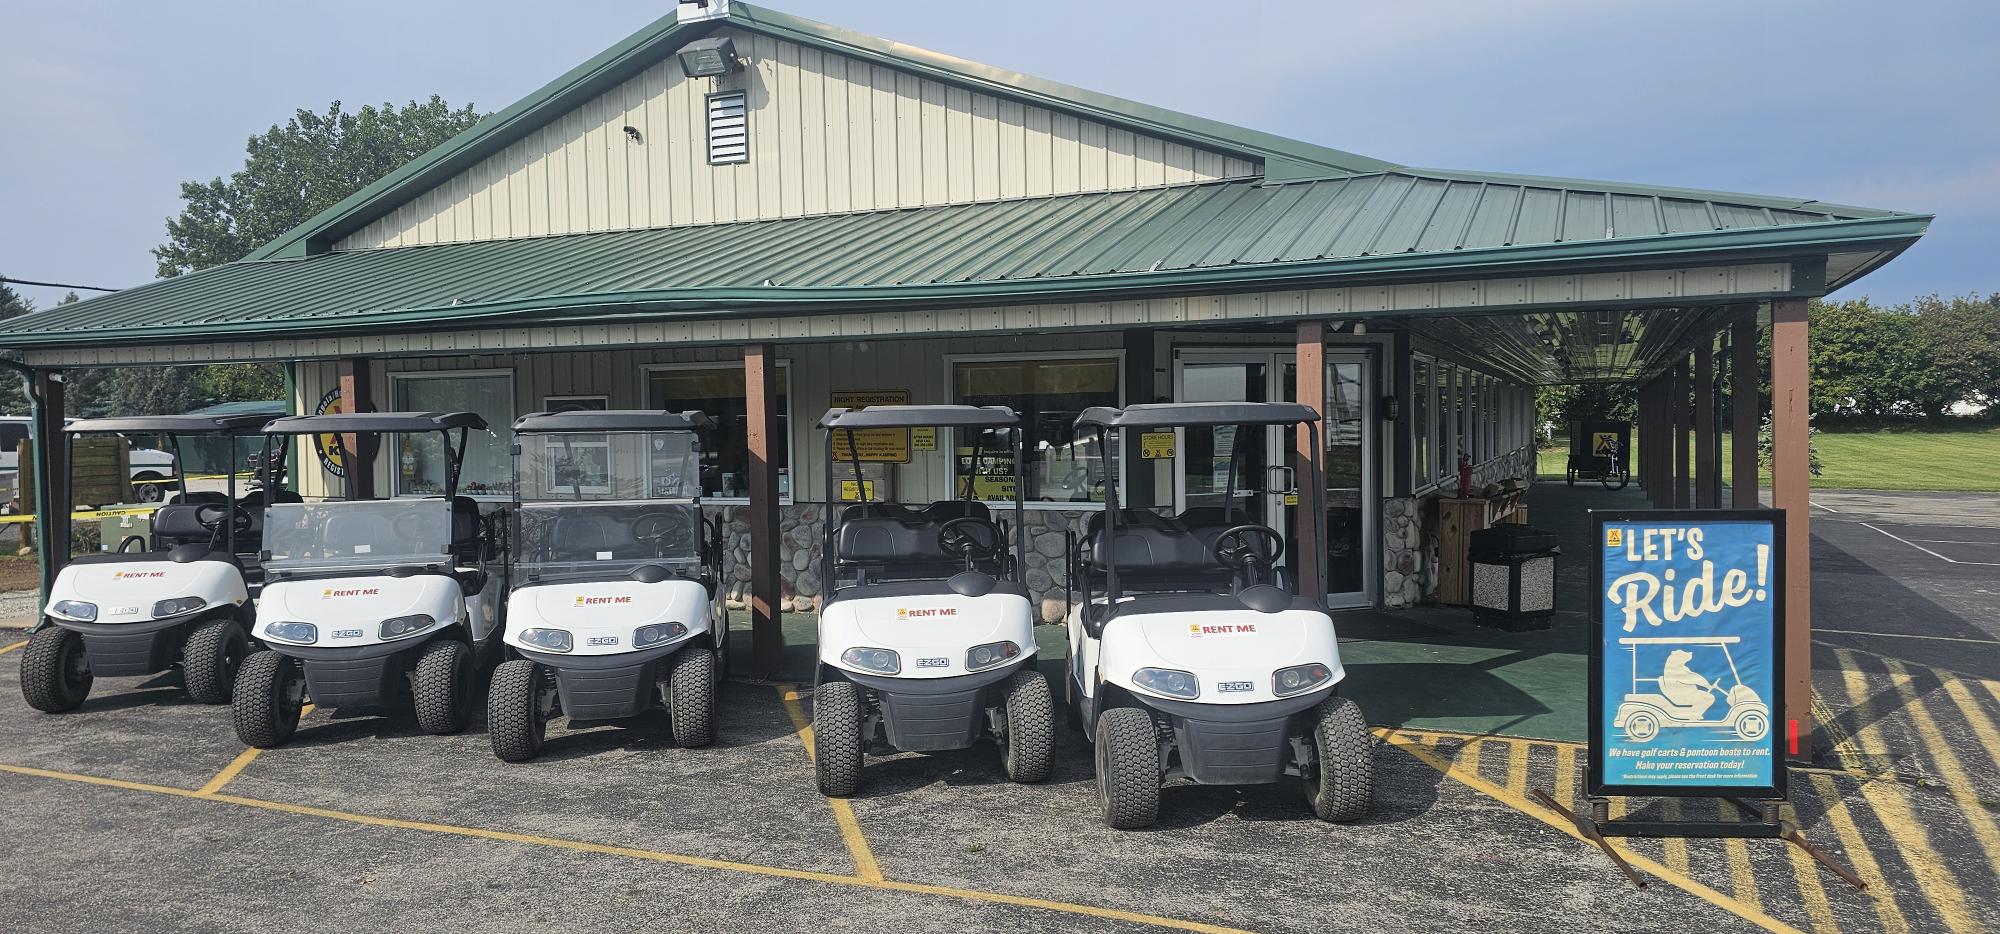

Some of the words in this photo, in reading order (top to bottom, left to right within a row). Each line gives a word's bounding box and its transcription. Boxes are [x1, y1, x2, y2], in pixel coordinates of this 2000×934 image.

[857, 395, 905, 403] REGISTRATION
[323, 458, 344, 476] REGIST
[993, 467, 1008, 475] US?
[1627, 527, 1704, 562] LET'S
[1607, 544, 1769, 632] Ride!
[333, 589, 361, 597] RENT
[585, 597, 613, 605] RENT
[614, 596, 632, 604] ME
[909, 609, 937, 617] RENT
[939, 608, 957, 616] ME
[1202, 625, 1233, 634] RENT
[1236, 624, 1257, 633] ME
[1218, 682, 1252, 691] EZGO
[1609, 748, 1621, 757] We
[1621, 748, 1640, 757] have
[1640, 747, 1658, 758] golf
[1657, 749, 1679, 757] carts
[1679, 747, 1686, 757] &
[1686, 748, 1719, 758] pontoon
[1719, 747, 1742, 756] boats
[1742, 748, 1751, 756] to
[1751, 747, 1771, 756] rent.
[1635, 761, 1656, 770] Make
[1656, 762, 1675, 771] your
[1674, 760, 1719, 769] reservation
[1720, 760, 1745, 770] today!
